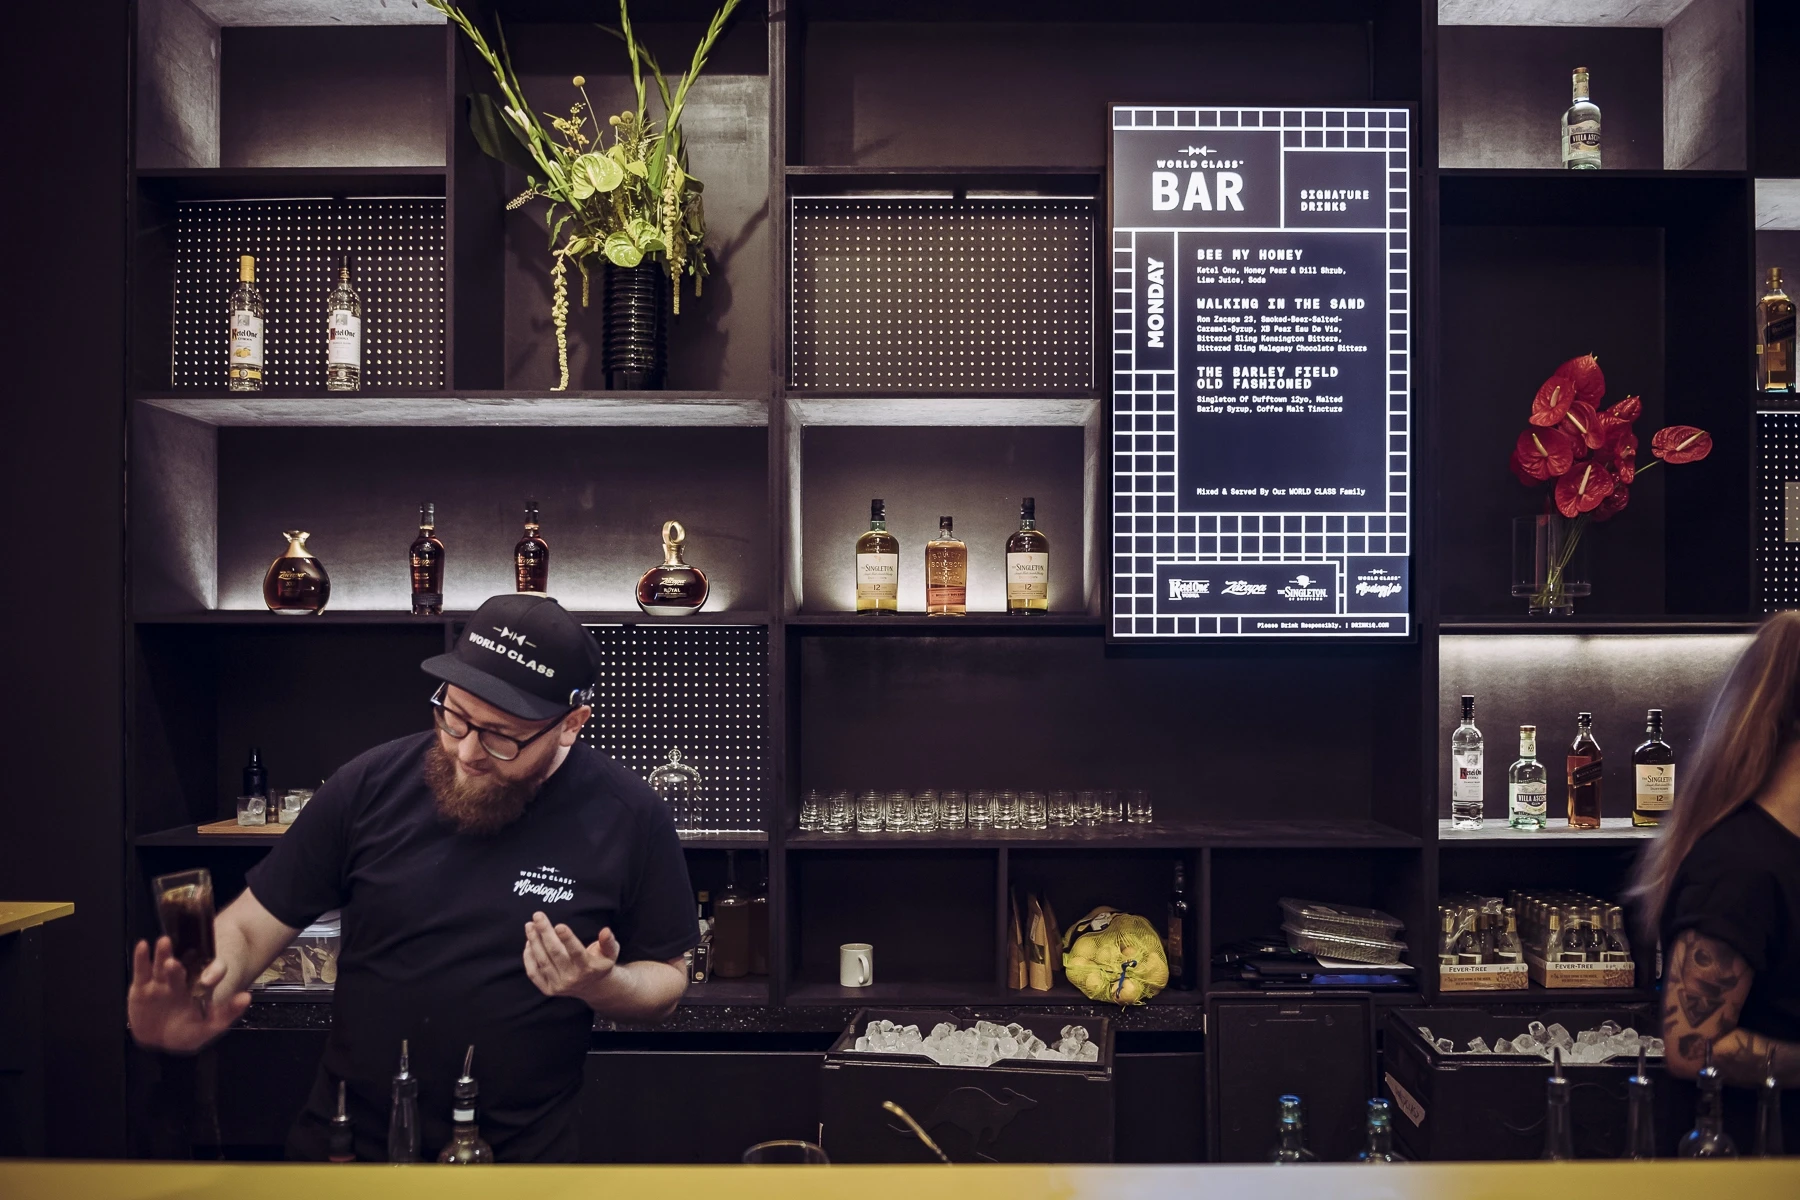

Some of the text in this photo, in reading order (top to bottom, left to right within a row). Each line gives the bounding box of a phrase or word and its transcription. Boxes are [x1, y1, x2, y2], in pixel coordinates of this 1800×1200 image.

[1157, 160, 1240, 168] WORLD CLASS
[1152, 171, 1244, 211] BAR
[1301, 190, 1369, 199] SIGNATURE
[1301, 202, 1346, 211] DRINKS
[1198, 249, 1302, 260] BEE MY HONEY
[1197, 266, 1218, 274] Ketel
[1244, 267, 1266, 275] Honey
[1219, 276, 1243, 284] Juice,
[1147, 257, 1164, 348] MONDAY
[1197, 298, 1365, 309] WALKING IN THE SAND
[1197, 325, 1256, 333] Caramel-Syrup,
[246, 330, 258, 338] One
[1236, 335, 1257, 343] Sling
[1261, 335, 1304, 343] Kensington
[1235, 345, 1256, 353] Sling
[1197, 367, 1338, 377] THE BARLEY FIELD
[1197, 378, 1311, 389] OLD FASHIONED
[1197, 396, 1236, 404] Singleton
[1291, 396, 1312, 404] 12yo,
[1260, 488, 1269, 496] By
[1340, 488, 1365, 496] Family
[469, 632, 555, 678] WORLD CLASS
[1518, 794, 1532, 802] VILLA
[520, 870, 572, 885] WORLD CLASS
